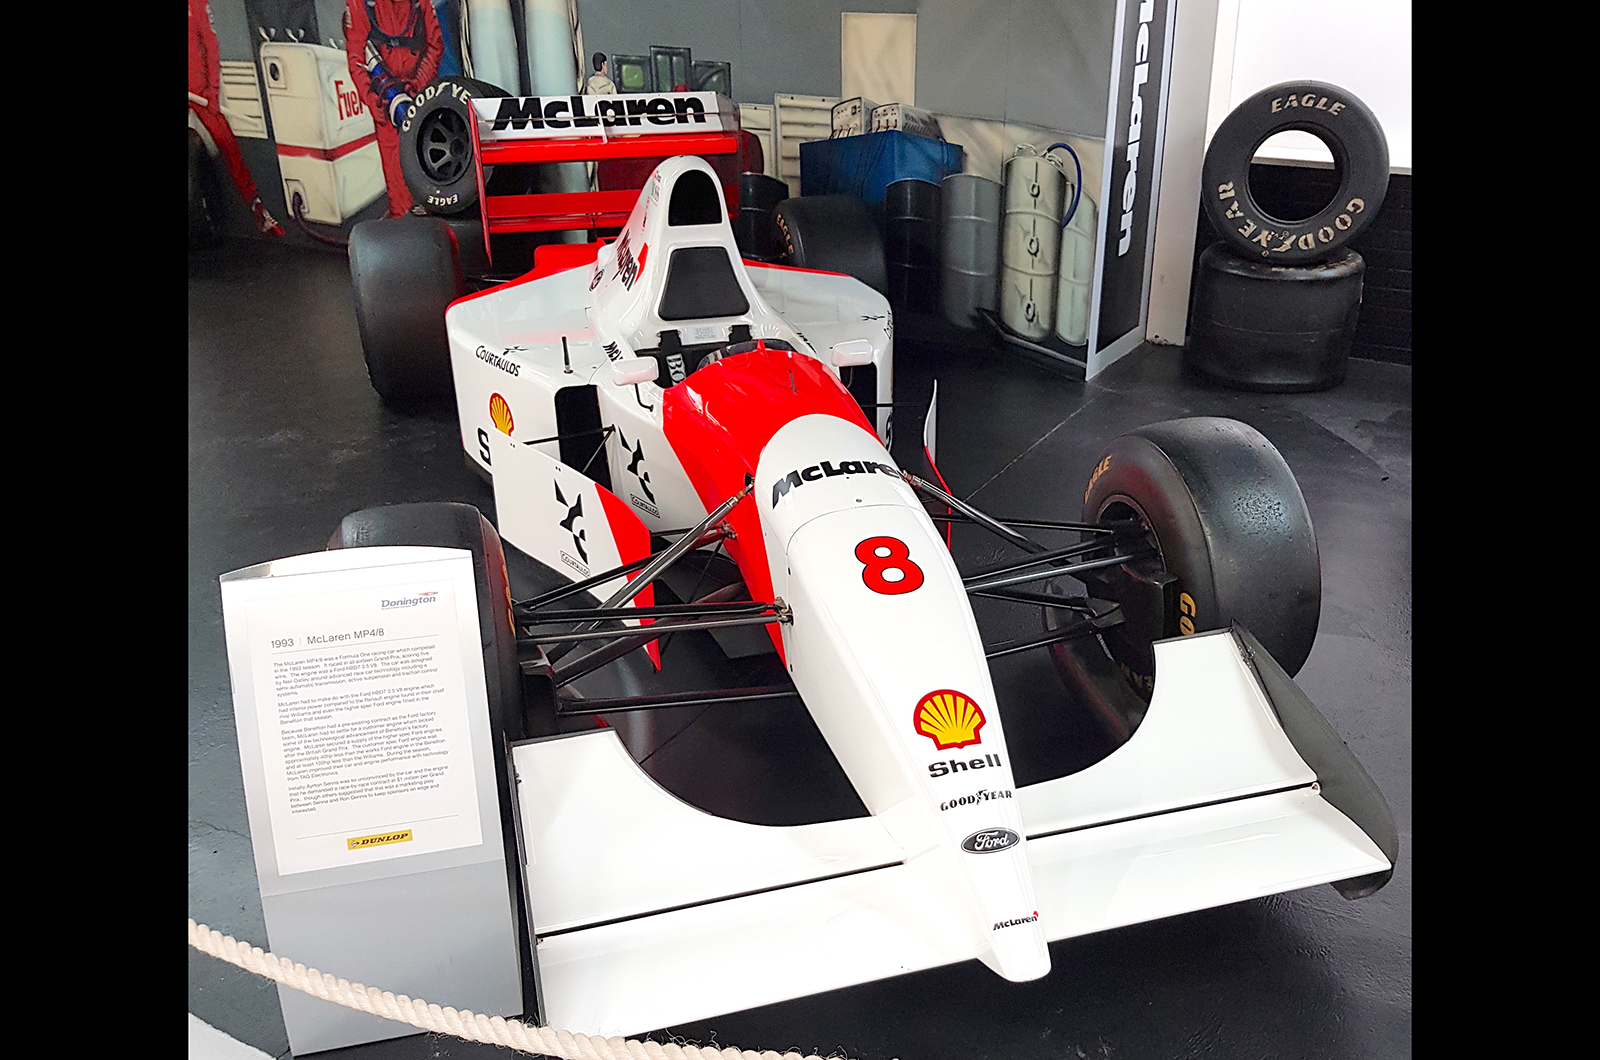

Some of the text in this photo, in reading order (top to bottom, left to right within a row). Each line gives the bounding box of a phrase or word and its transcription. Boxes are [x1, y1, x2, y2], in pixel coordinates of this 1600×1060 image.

[491, 94, 707, 131] McLaren
[1271, 93, 1347, 116] EAGLE
[427, 194, 459, 206] EAGLE
[1218, 181, 1366, 253] GOODYEAR
[475, 344, 521, 377] COURTAULDS
[772, 460, 906, 510] McLare
[854, 535, 925, 596] 8
[380, 595, 437, 608] Donington
[270, 627, 385, 649] 1993 McLaren MP4/8
[928, 753, 1003, 779] Shell
[940, 789, 1013, 812] GOODYEAR
[360, 831, 410, 846] DUNLOP
[973, 830, 1010, 851] Ford
[992, 913, 1039, 931] McLaren
